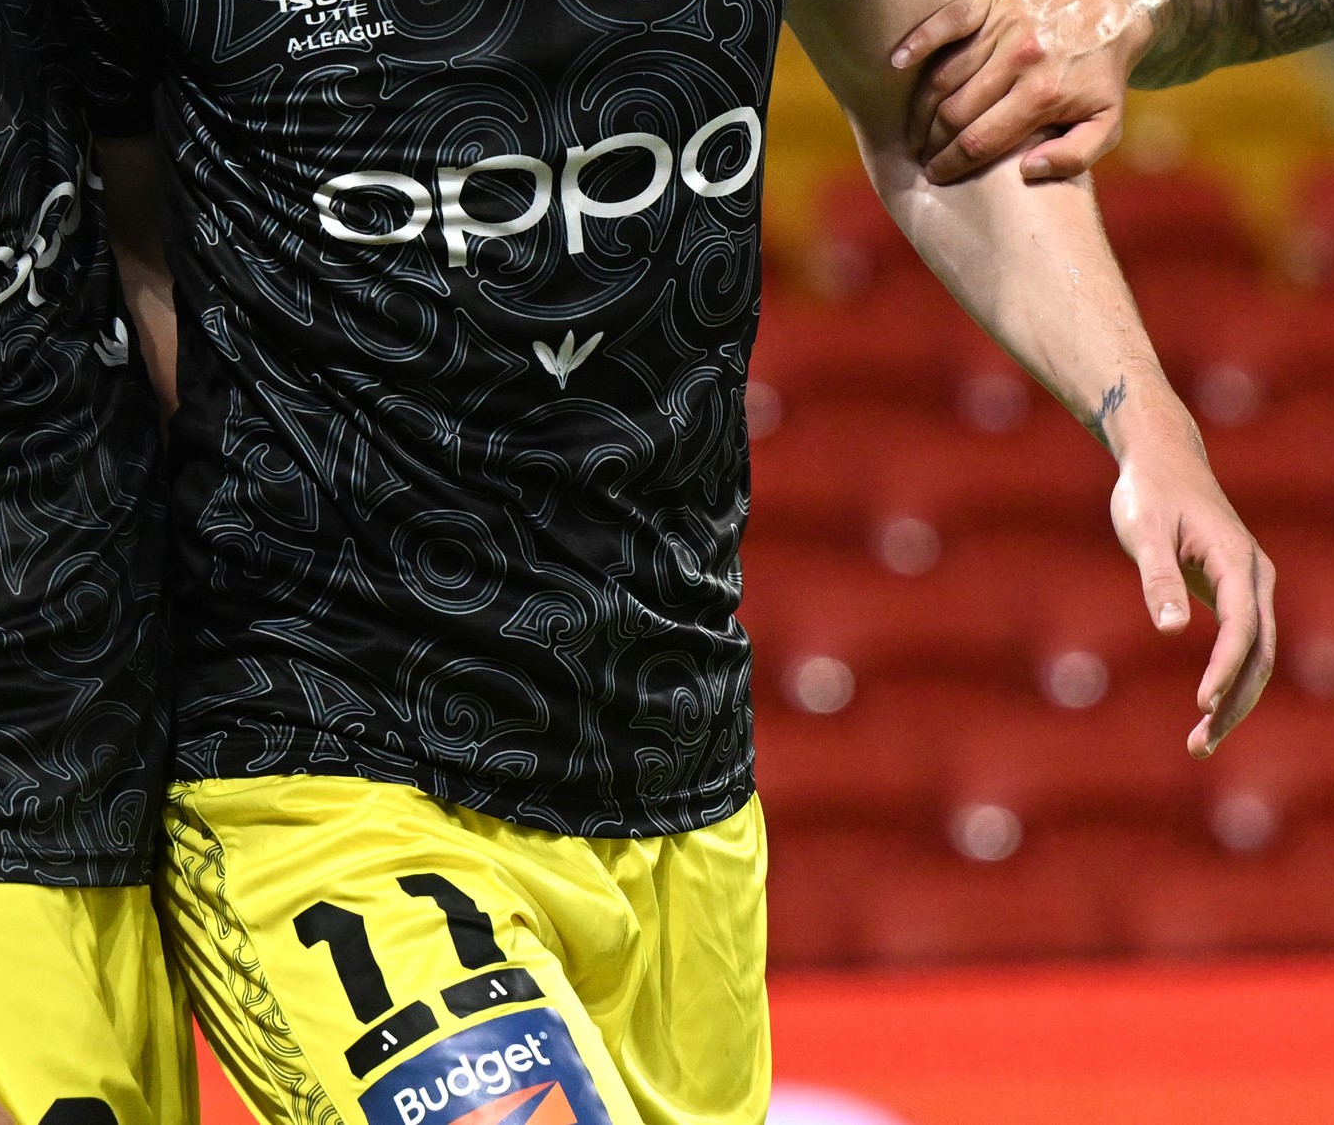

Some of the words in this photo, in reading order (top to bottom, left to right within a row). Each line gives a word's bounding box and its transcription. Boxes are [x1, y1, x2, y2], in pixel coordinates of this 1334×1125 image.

[287, 19, 396, 53] A-LEAGUE
[305, 3, 369, 25] UTE
[312, 106, 762, 268] oppo
[293, 872, 547, 1080] 11
[393, 1033, 551, 1125] Budget
